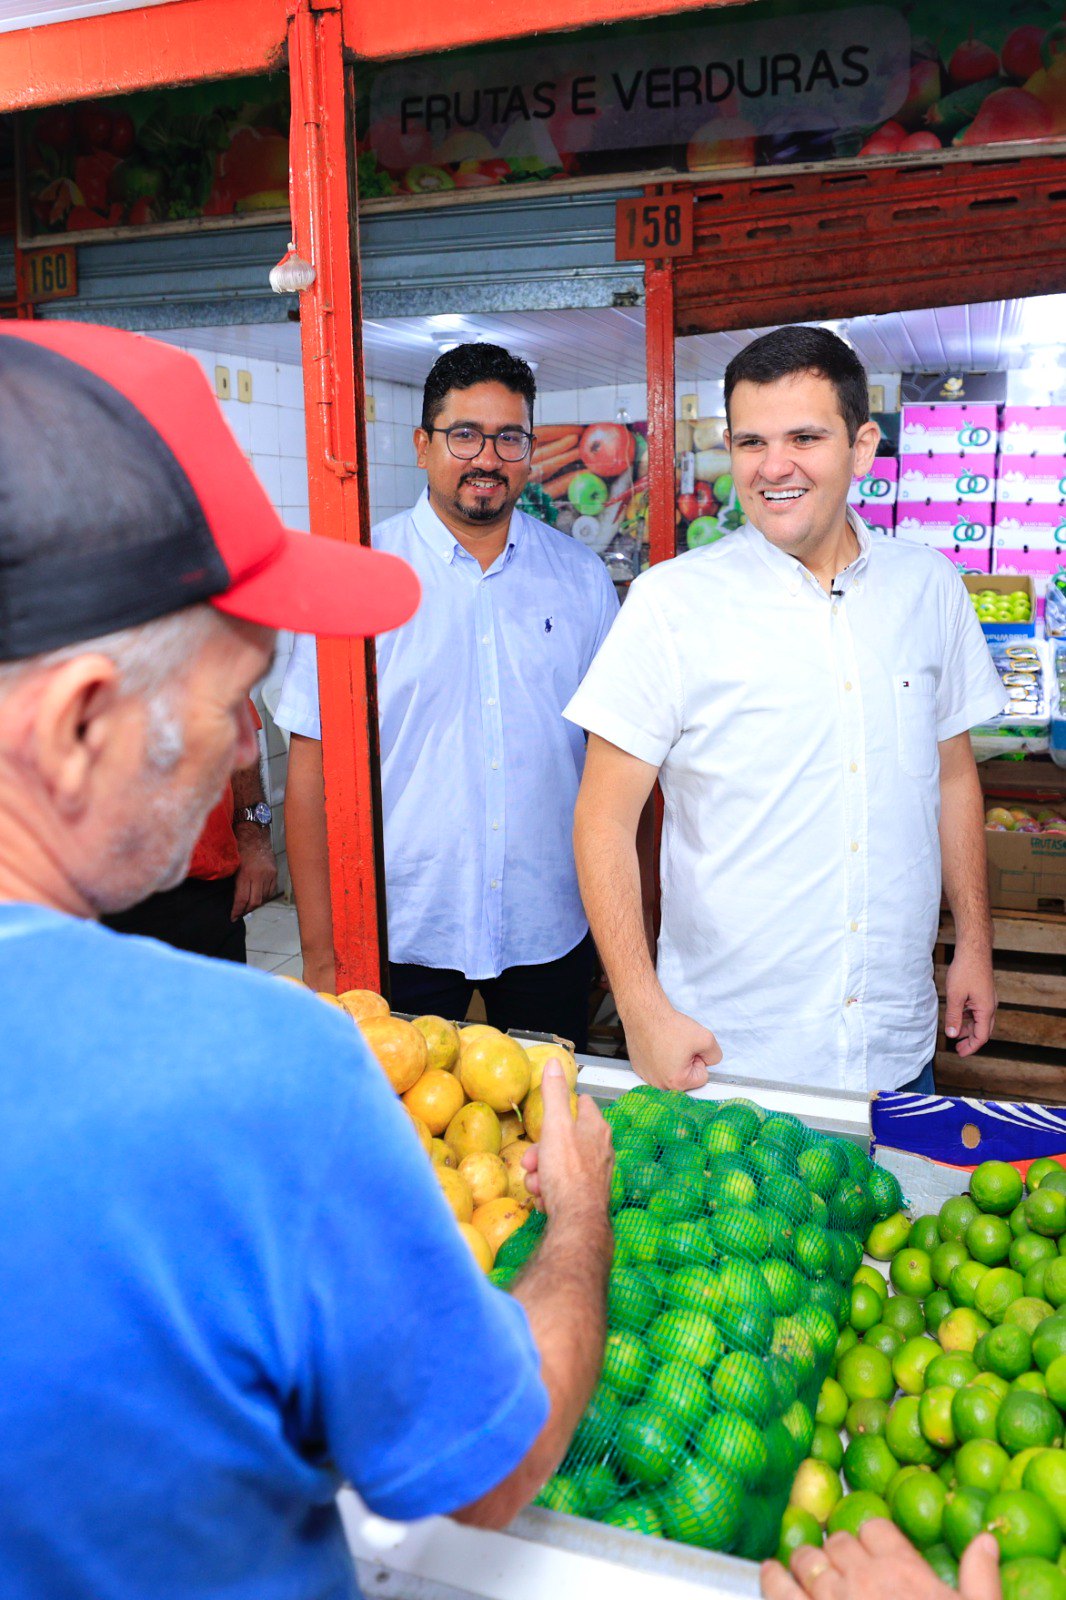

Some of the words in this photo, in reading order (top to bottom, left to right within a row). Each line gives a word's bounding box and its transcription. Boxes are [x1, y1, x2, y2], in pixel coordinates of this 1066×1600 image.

[401, 80, 557, 135] FRUTAS
[571, 75, 597, 117] E
[611, 45, 870, 112] VERDURAS
[626, 205, 682, 249] 158
[31, 253, 67, 295] 160
